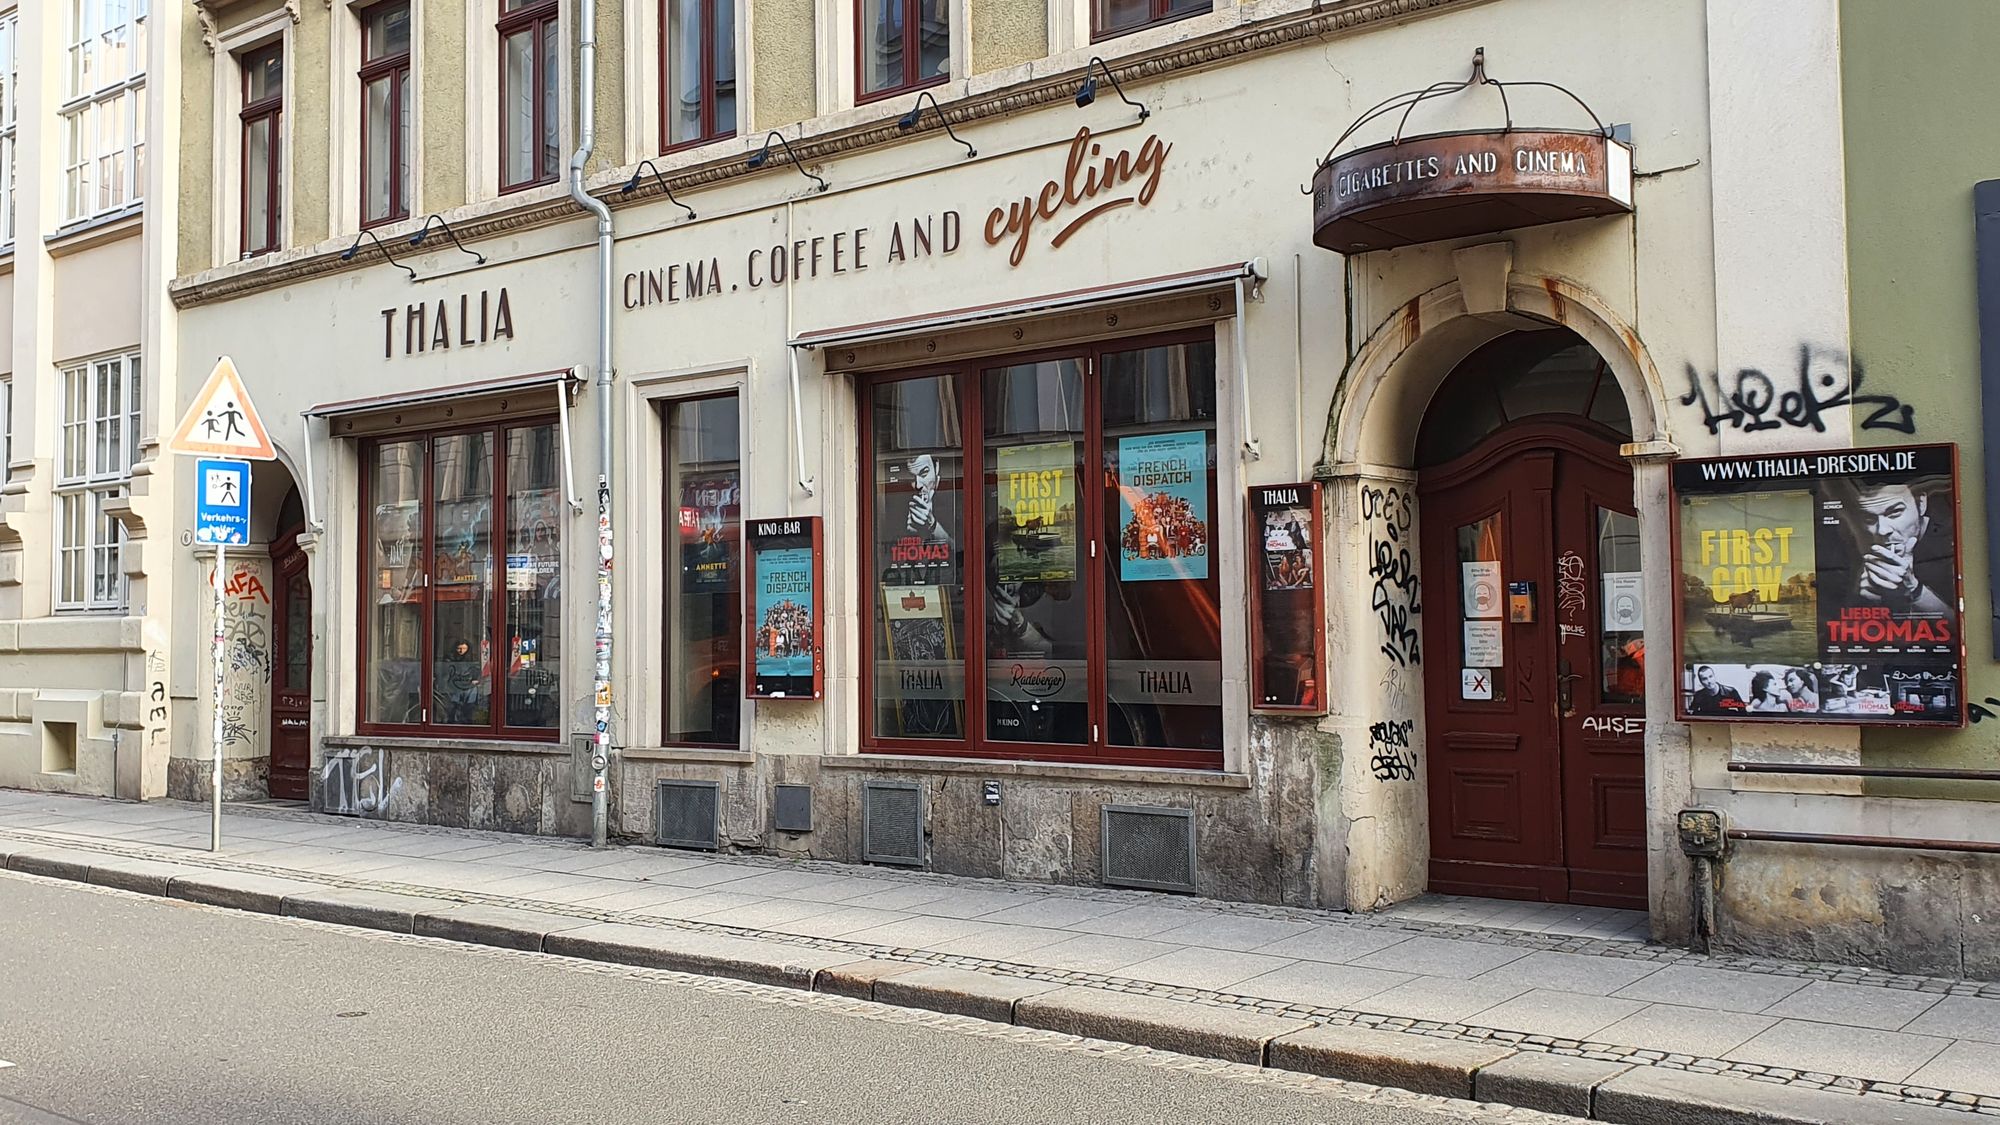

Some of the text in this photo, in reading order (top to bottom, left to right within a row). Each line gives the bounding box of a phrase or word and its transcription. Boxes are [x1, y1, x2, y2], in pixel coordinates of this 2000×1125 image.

[1338, 150, 1587, 197] CIGARETTES AND CINEMA
[888, 210, 961, 264] AND
[984, 126, 1174, 267] cycling
[381, 287, 513, 358] THALIA
[1138, 459, 1187, 474] FRENCH
[1701, 451, 1917, 481] WWW.THALIA-DRESDEN.DE
[1010, 469, 1063, 500] FIRST
[1133, 471, 1192, 487] DISPATCH
[1262, 489, 1299, 505] THALIA
[1015, 498, 1057, 527] COW
[758, 521, 800, 536] KINO & BAR
[891, 544, 949, 561] THOMAS
[1701, 527, 1793, 566] FIRST
[696, 562, 727, 571] ANNETTE
[770, 571, 807, 582] FRENCH
[766, 582, 810, 593] DISPATCH
[1712, 566, 1783, 603] COW
[1841, 607, 1892, 620] LIEBER
[1827, 619, 1952, 643] THOMAS
[900, 669, 943, 690] THALIA
[1010, 664, 1062, 690] Radeberger
[1138, 669, 1193, 694] THALIA
[1858, 703, 1889, 711] THOMAS
